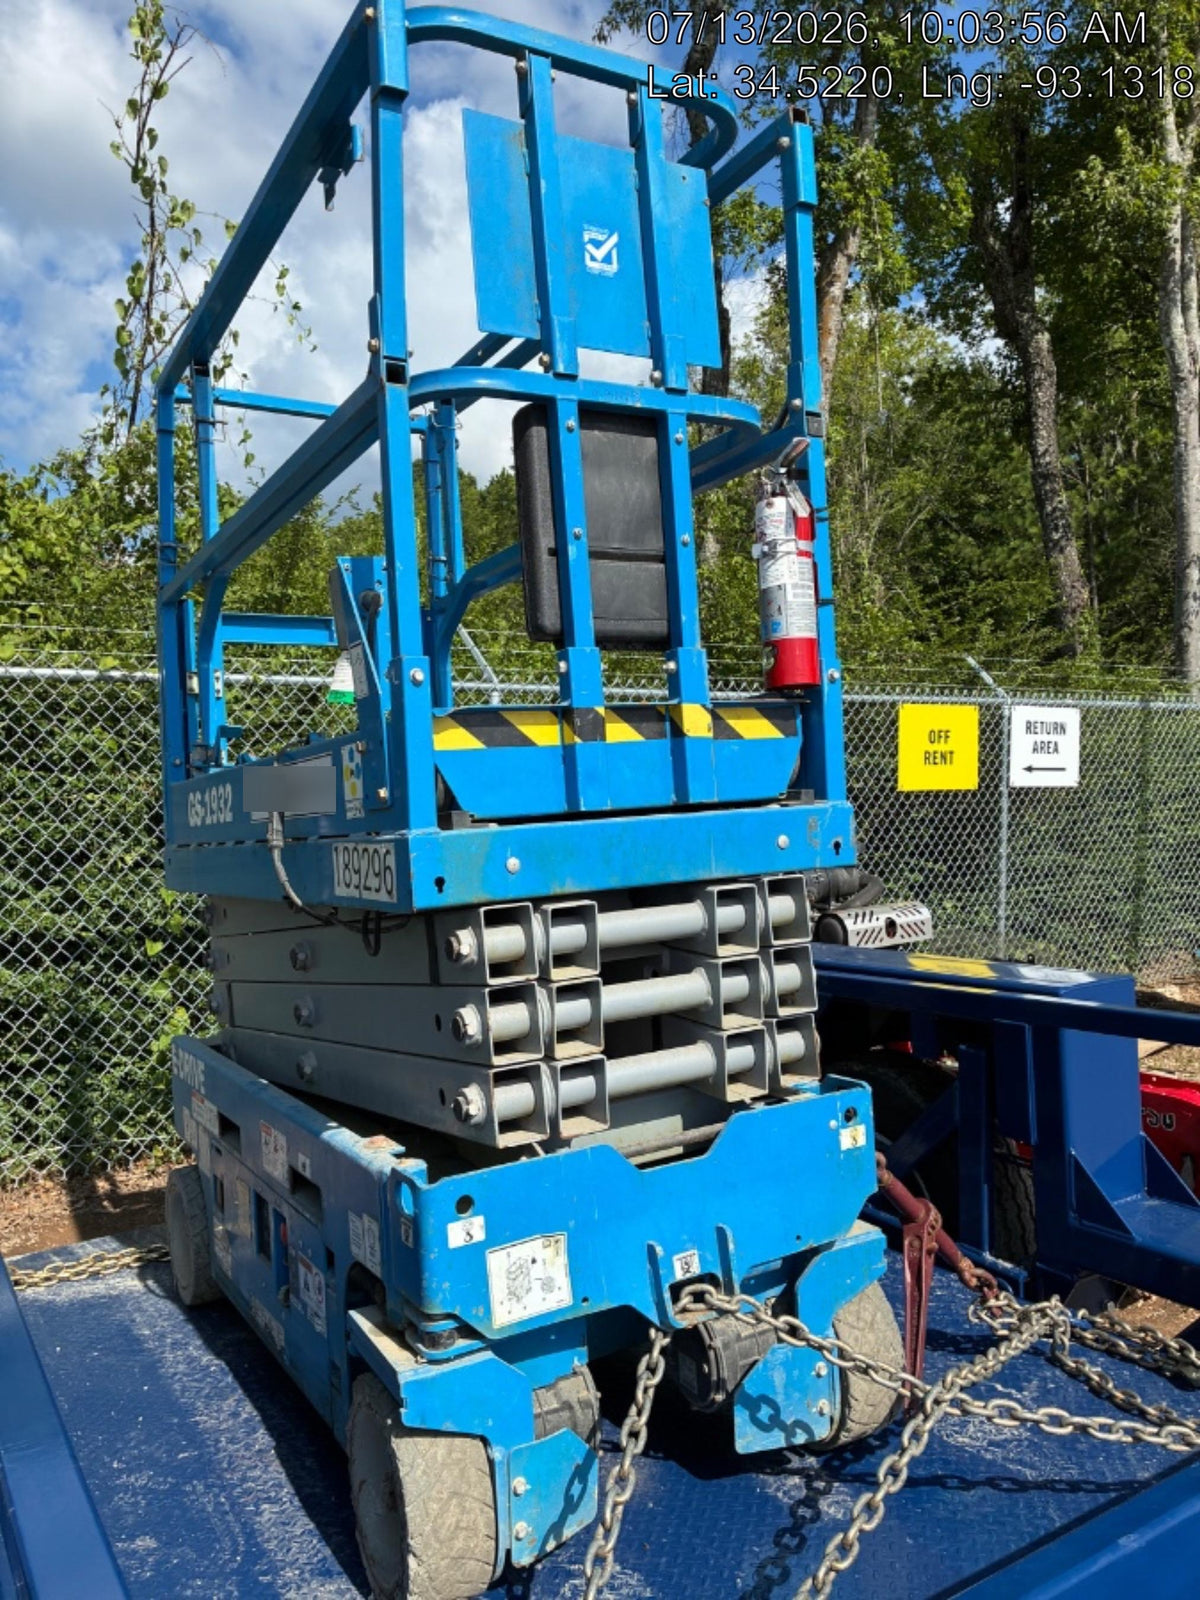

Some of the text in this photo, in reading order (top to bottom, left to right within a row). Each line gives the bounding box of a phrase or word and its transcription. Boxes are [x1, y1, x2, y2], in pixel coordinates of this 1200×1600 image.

[1025, 720, 1067, 735] RETURN
[928, 729, 951, 744] OFF
[1032, 741, 1060, 754] AREA
[924, 750, 954, 765] RENT
[188, 782, 233, 827] GS-1932
[333, 845, 394, 898] 189296
